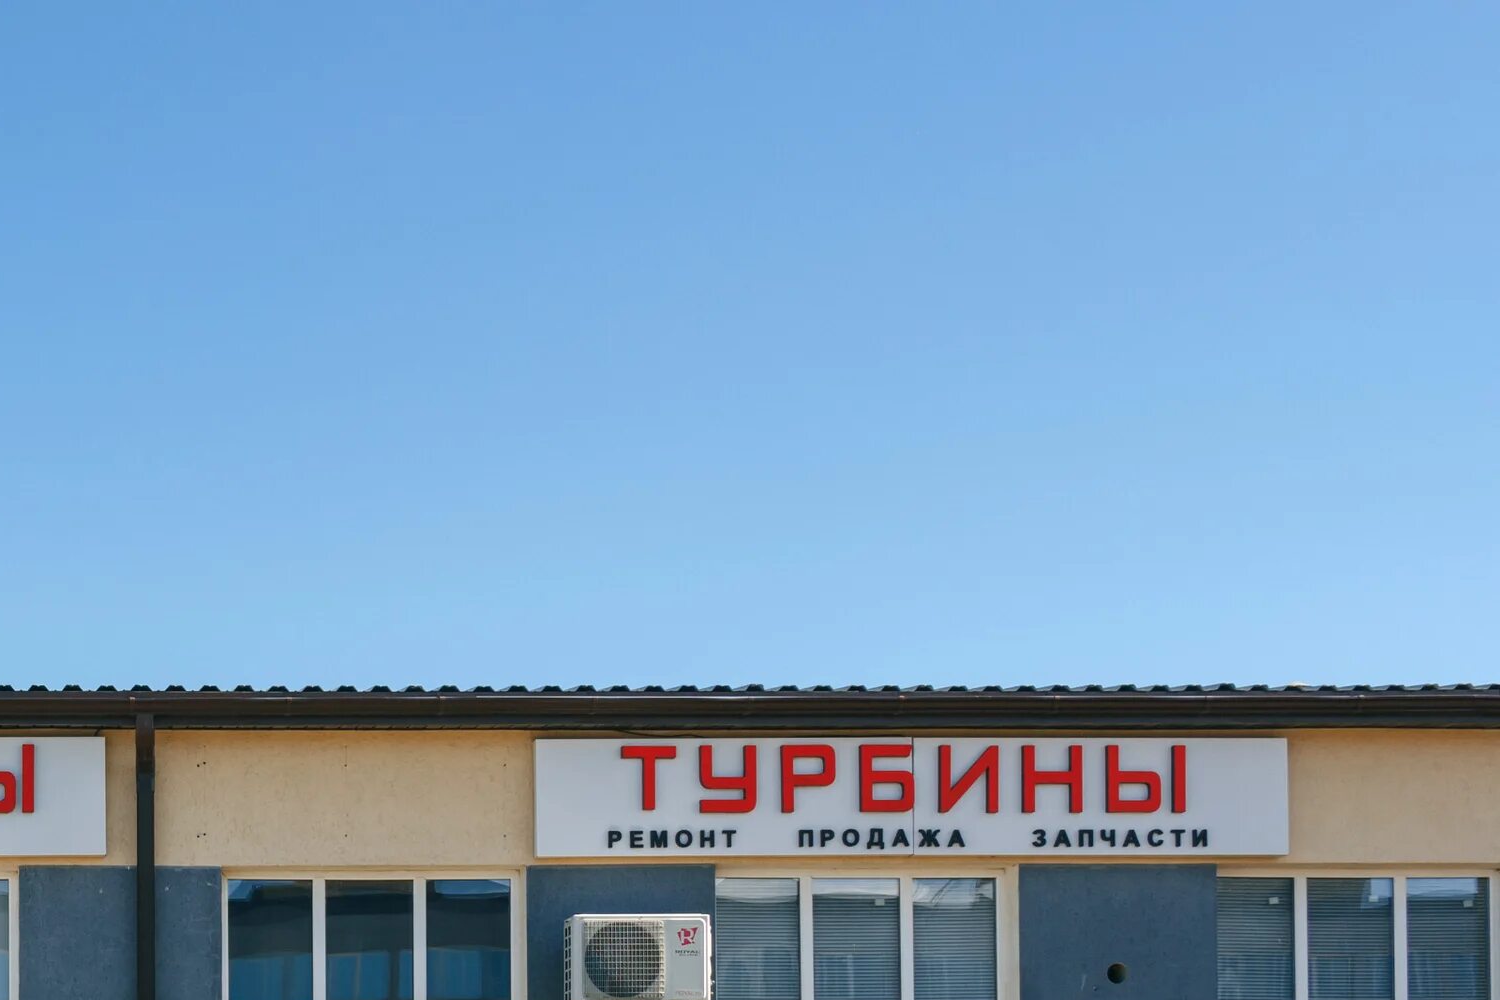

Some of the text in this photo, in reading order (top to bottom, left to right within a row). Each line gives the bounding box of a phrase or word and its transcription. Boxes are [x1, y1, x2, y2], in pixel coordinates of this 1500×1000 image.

[621, 744, 1187, 814] ТУРБИНЫ
[607, 828, 1210, 850] РЕМОНТ ПРОДАЖА ЗАПЧАСТИ
